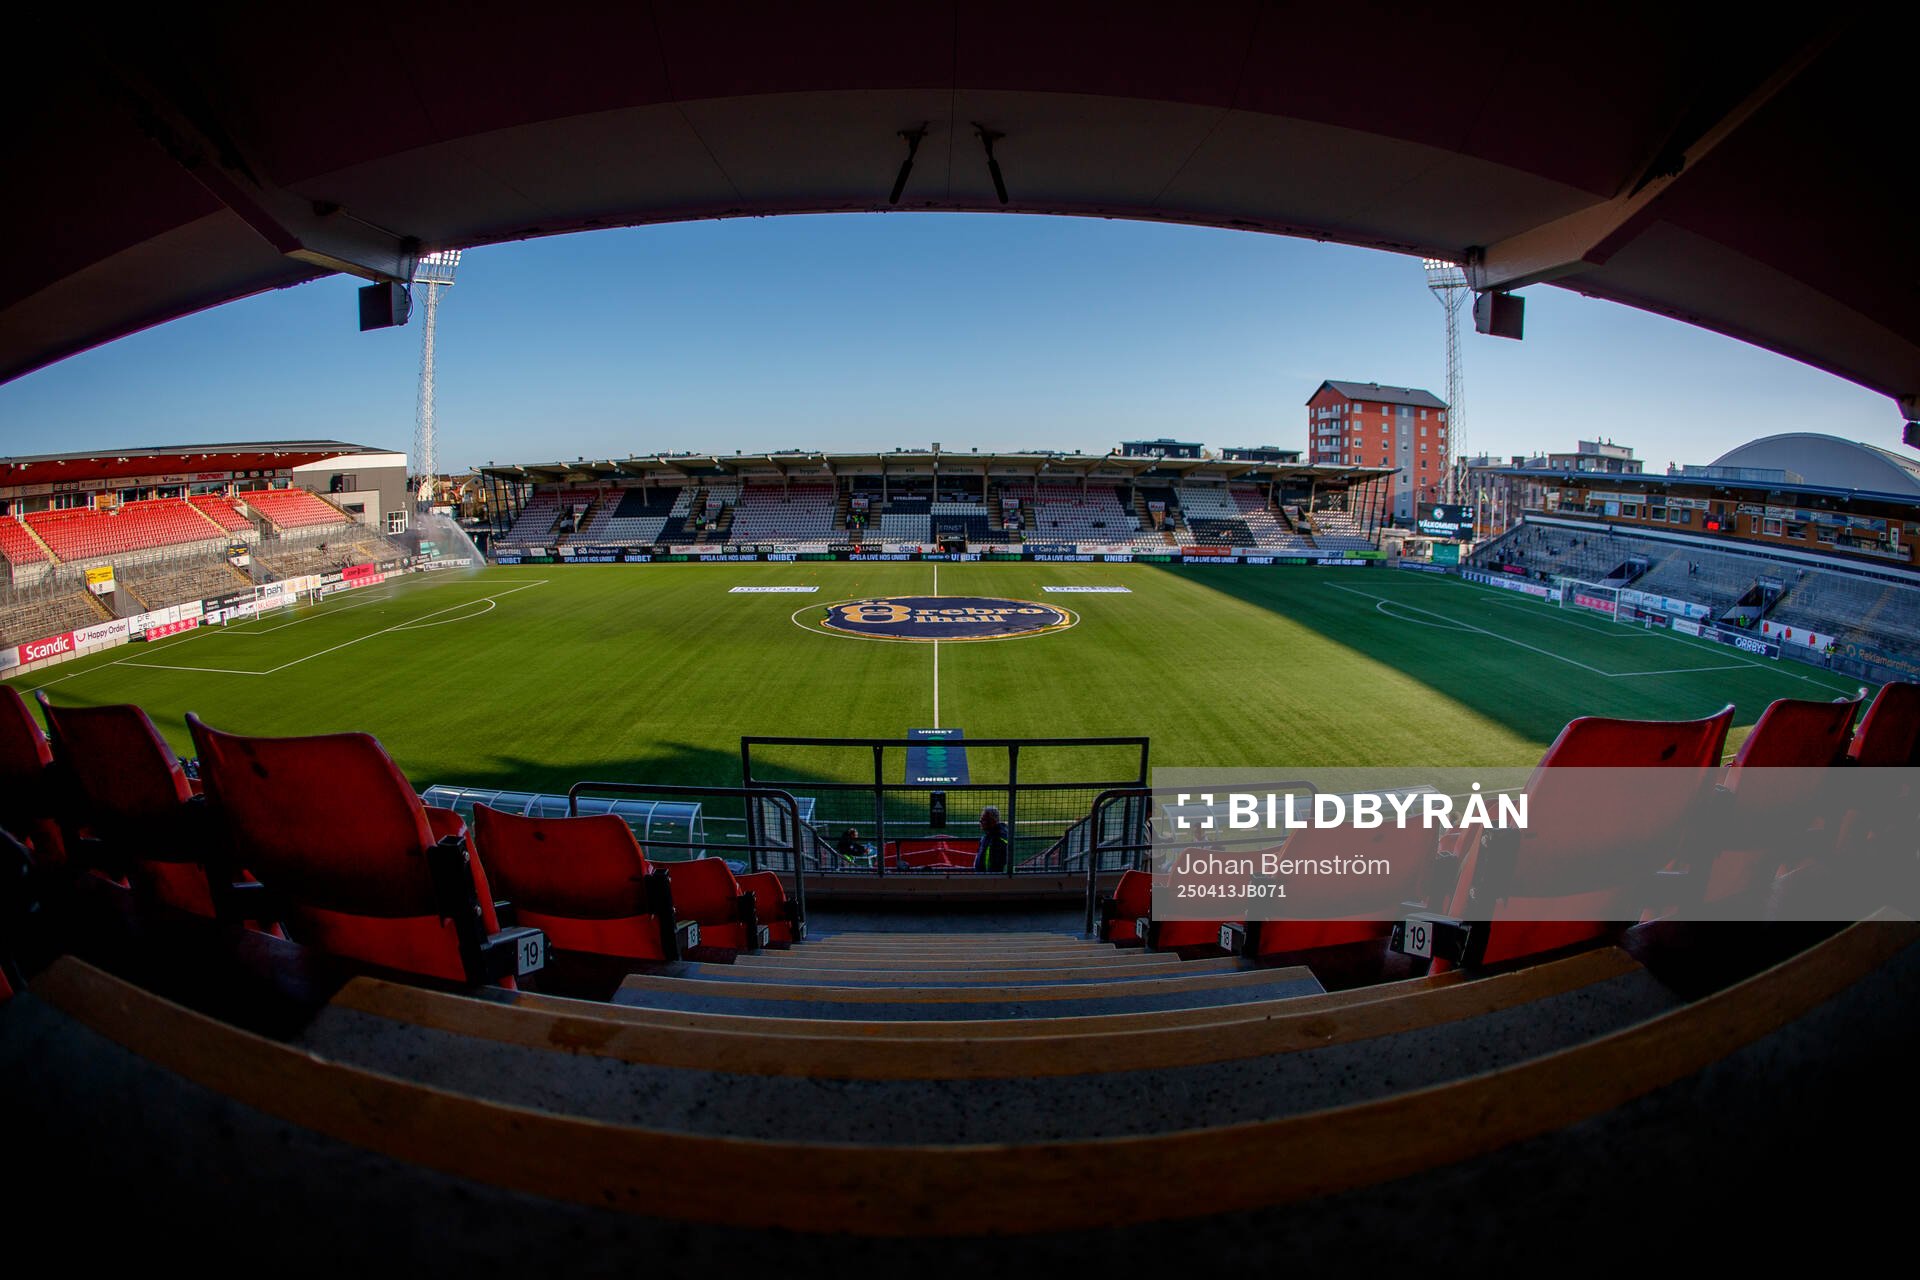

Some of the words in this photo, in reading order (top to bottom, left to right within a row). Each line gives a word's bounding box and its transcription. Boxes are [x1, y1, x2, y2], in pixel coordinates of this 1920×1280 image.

[1418, 520, 1459, 530] VÄLKOMMEN
[266, 584, 283, 597] pahl
[87, 629, 108, 641] Happy
[109, 623, 126, 635] Order
[26, 637, 70, 660] Scandic
[1735, 637, 1768, 655] ORRBYS
[1410, 926, 1426, 951] 19
[523, 941, 538, 967] 19
